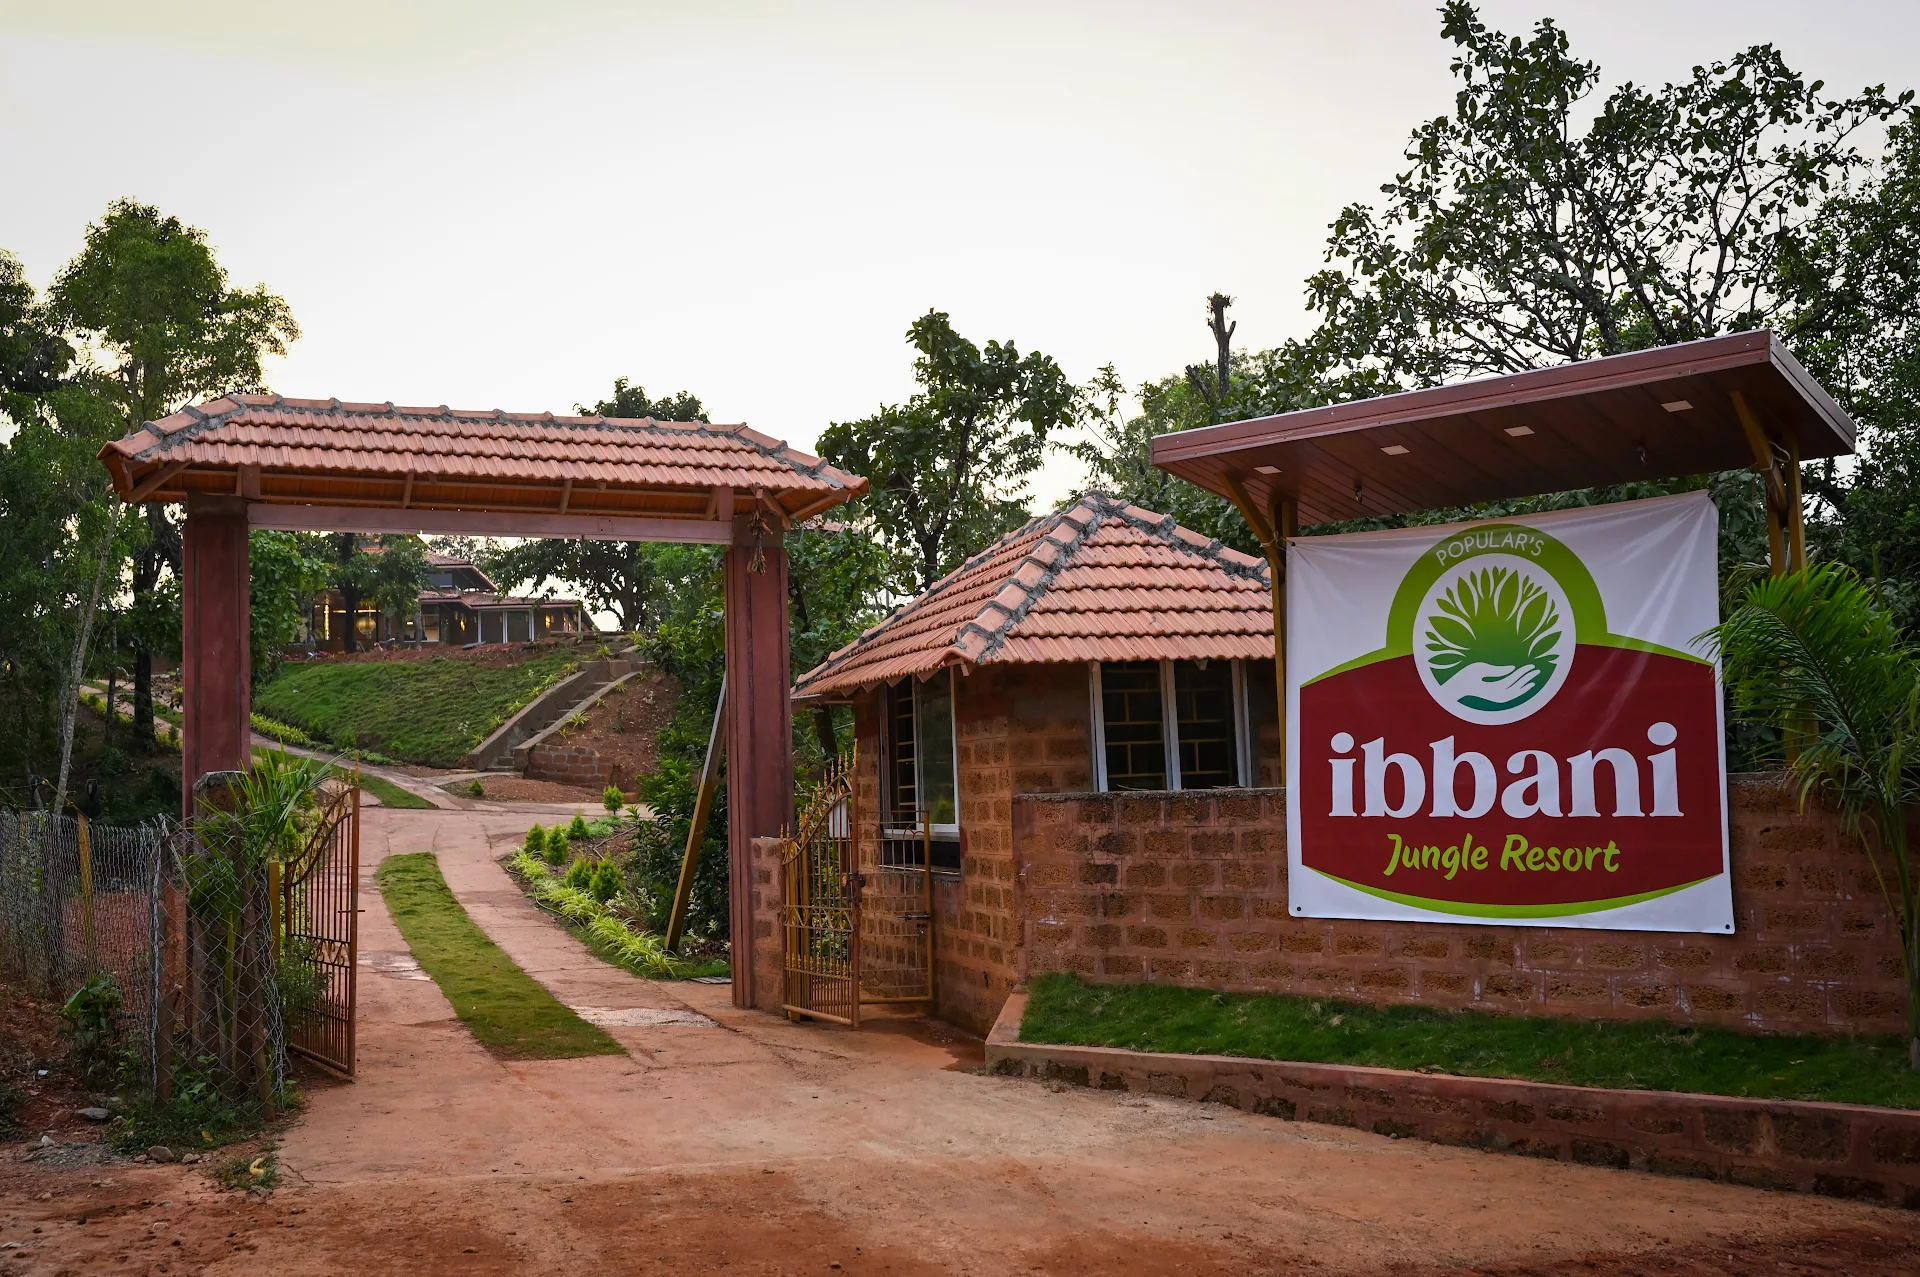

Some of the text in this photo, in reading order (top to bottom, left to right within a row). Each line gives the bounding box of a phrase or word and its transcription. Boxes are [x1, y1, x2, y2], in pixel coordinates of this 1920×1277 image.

[1435, 531, 1545, 567] POPULAR'S
[1328, 721, 1684, 818] ibbani
[1383, 833, 1620, 880] Jungle Resort
